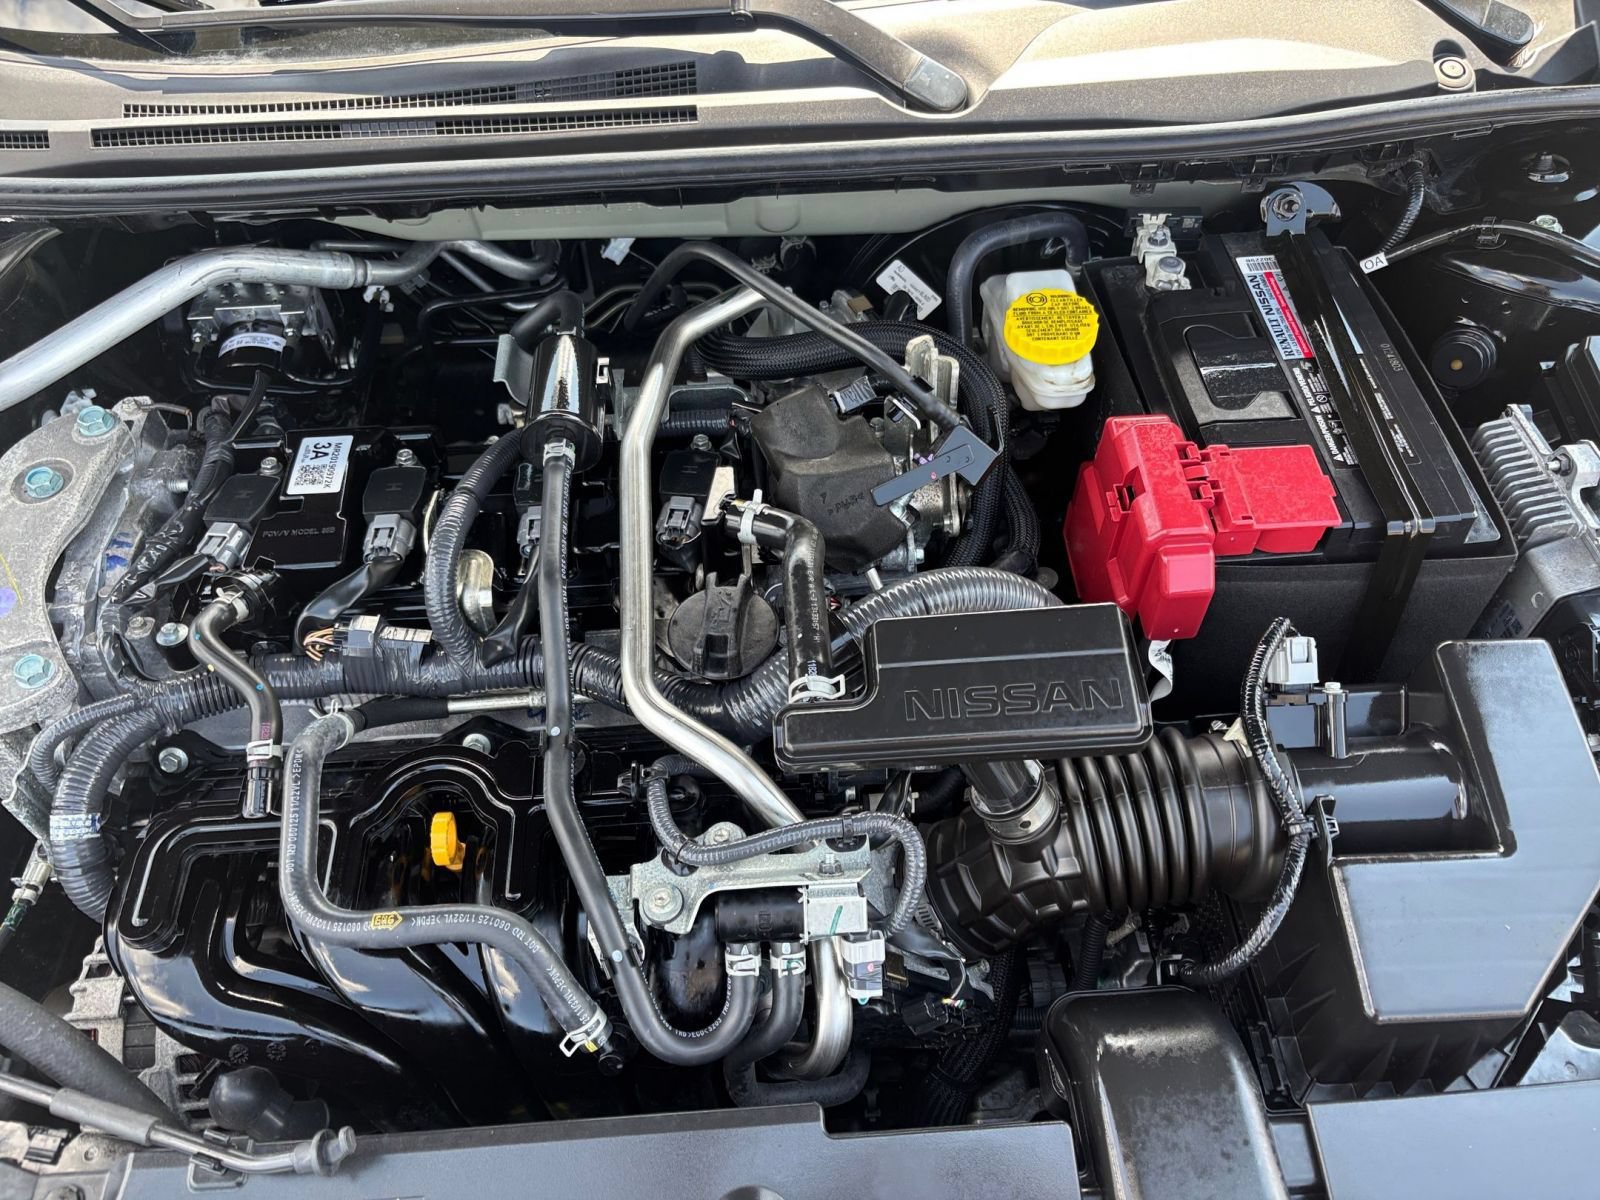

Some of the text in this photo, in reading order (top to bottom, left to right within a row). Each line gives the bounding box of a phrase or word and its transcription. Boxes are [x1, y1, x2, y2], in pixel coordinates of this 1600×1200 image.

[1248, 274, 1275, 316] NISSAN
[1268, 319, 1295, 357] RENAULT
[310, 442, 332, 460] 3A
[903, 678, 1124, 721] NISSAN
